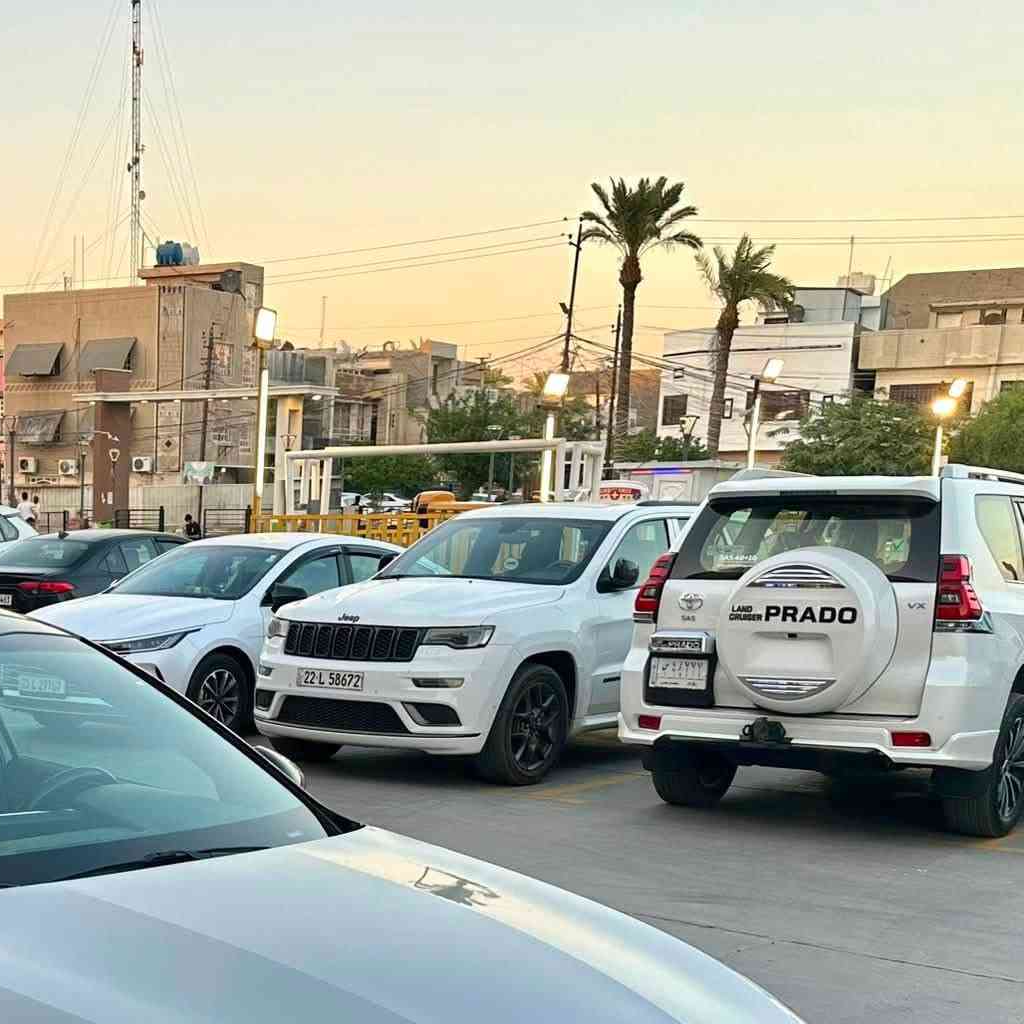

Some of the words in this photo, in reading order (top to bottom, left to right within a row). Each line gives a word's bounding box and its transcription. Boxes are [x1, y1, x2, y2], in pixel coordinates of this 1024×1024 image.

[731, 605, 753, 613] LAND
[338, 613, 360, 623] Jeep
[728, 613, 763, 622] CRUISER
[764, 605, 858, 625] PRADO
[328, 672, 361, 688] 58672
